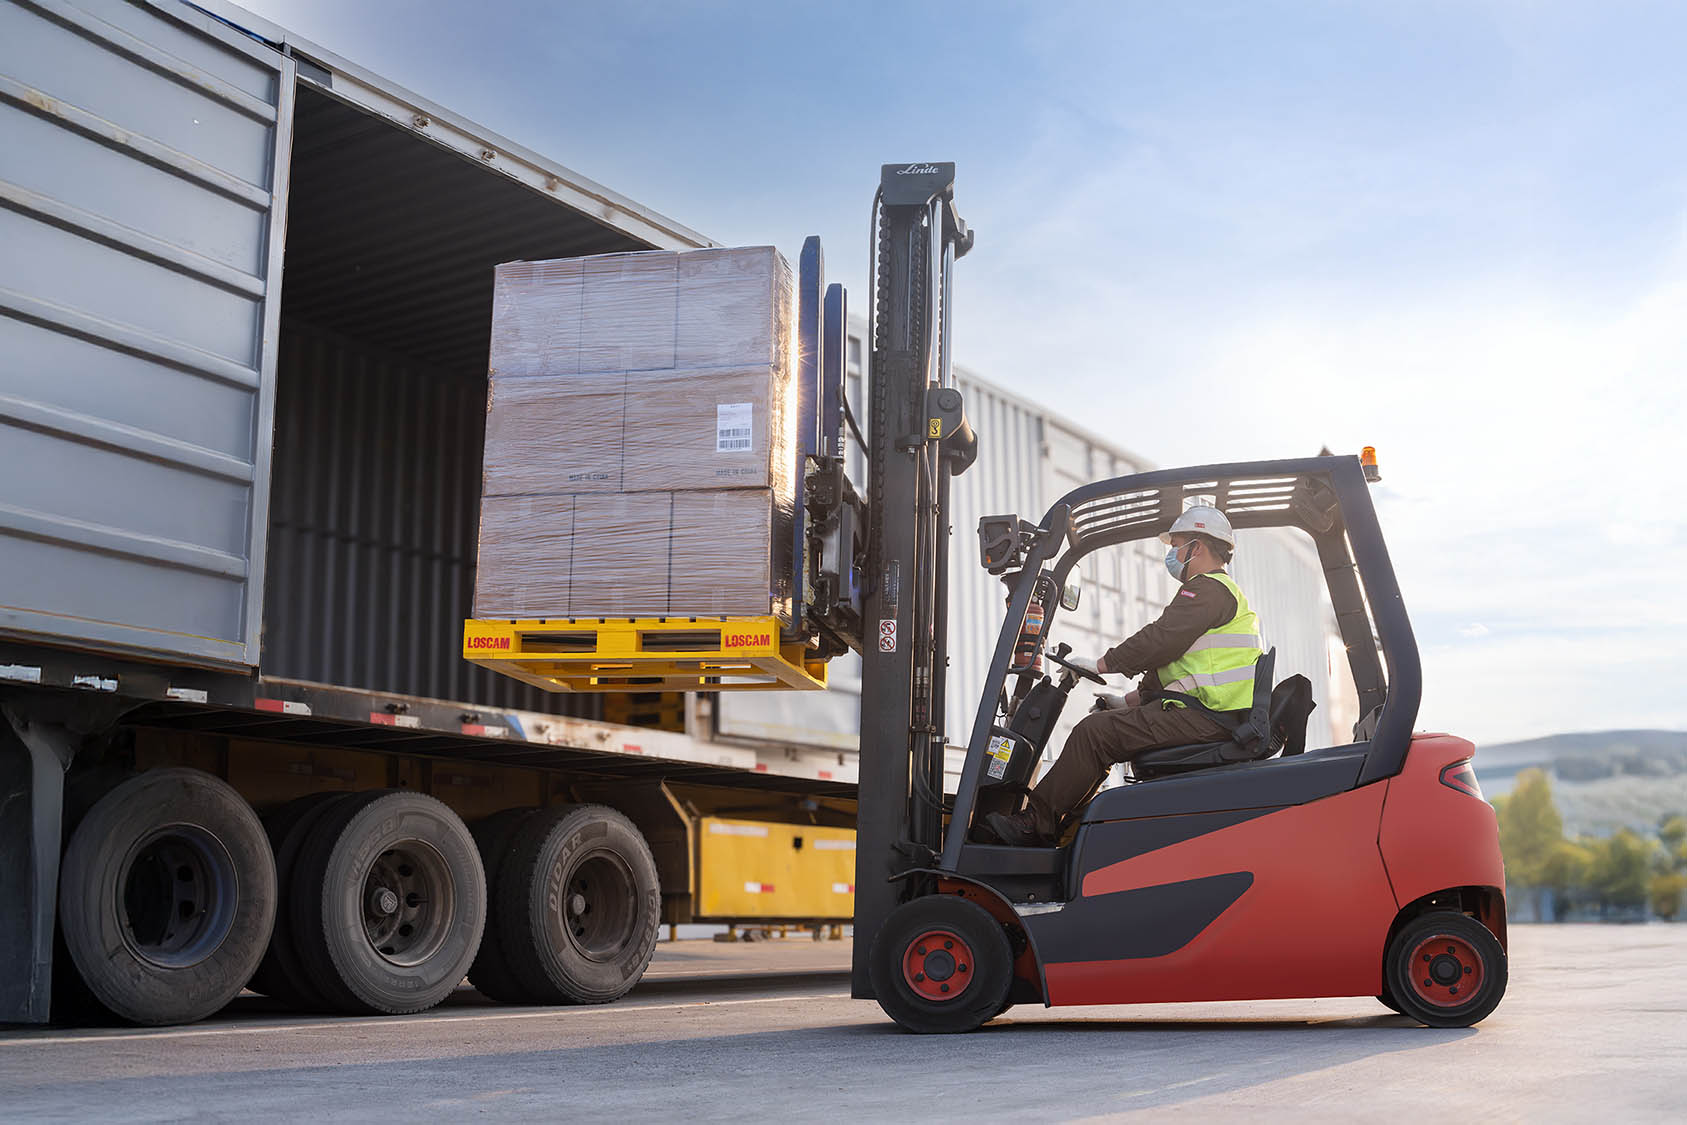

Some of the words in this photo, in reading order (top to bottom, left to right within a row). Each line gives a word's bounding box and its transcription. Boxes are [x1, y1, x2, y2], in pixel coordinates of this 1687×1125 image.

[897, 163, 939, 175] Linde
[467, 637, 511, 650] LOSCAM
[725, 634, 770, 648] LOSCAM
[549, 832, 582, 912] DIDAR
